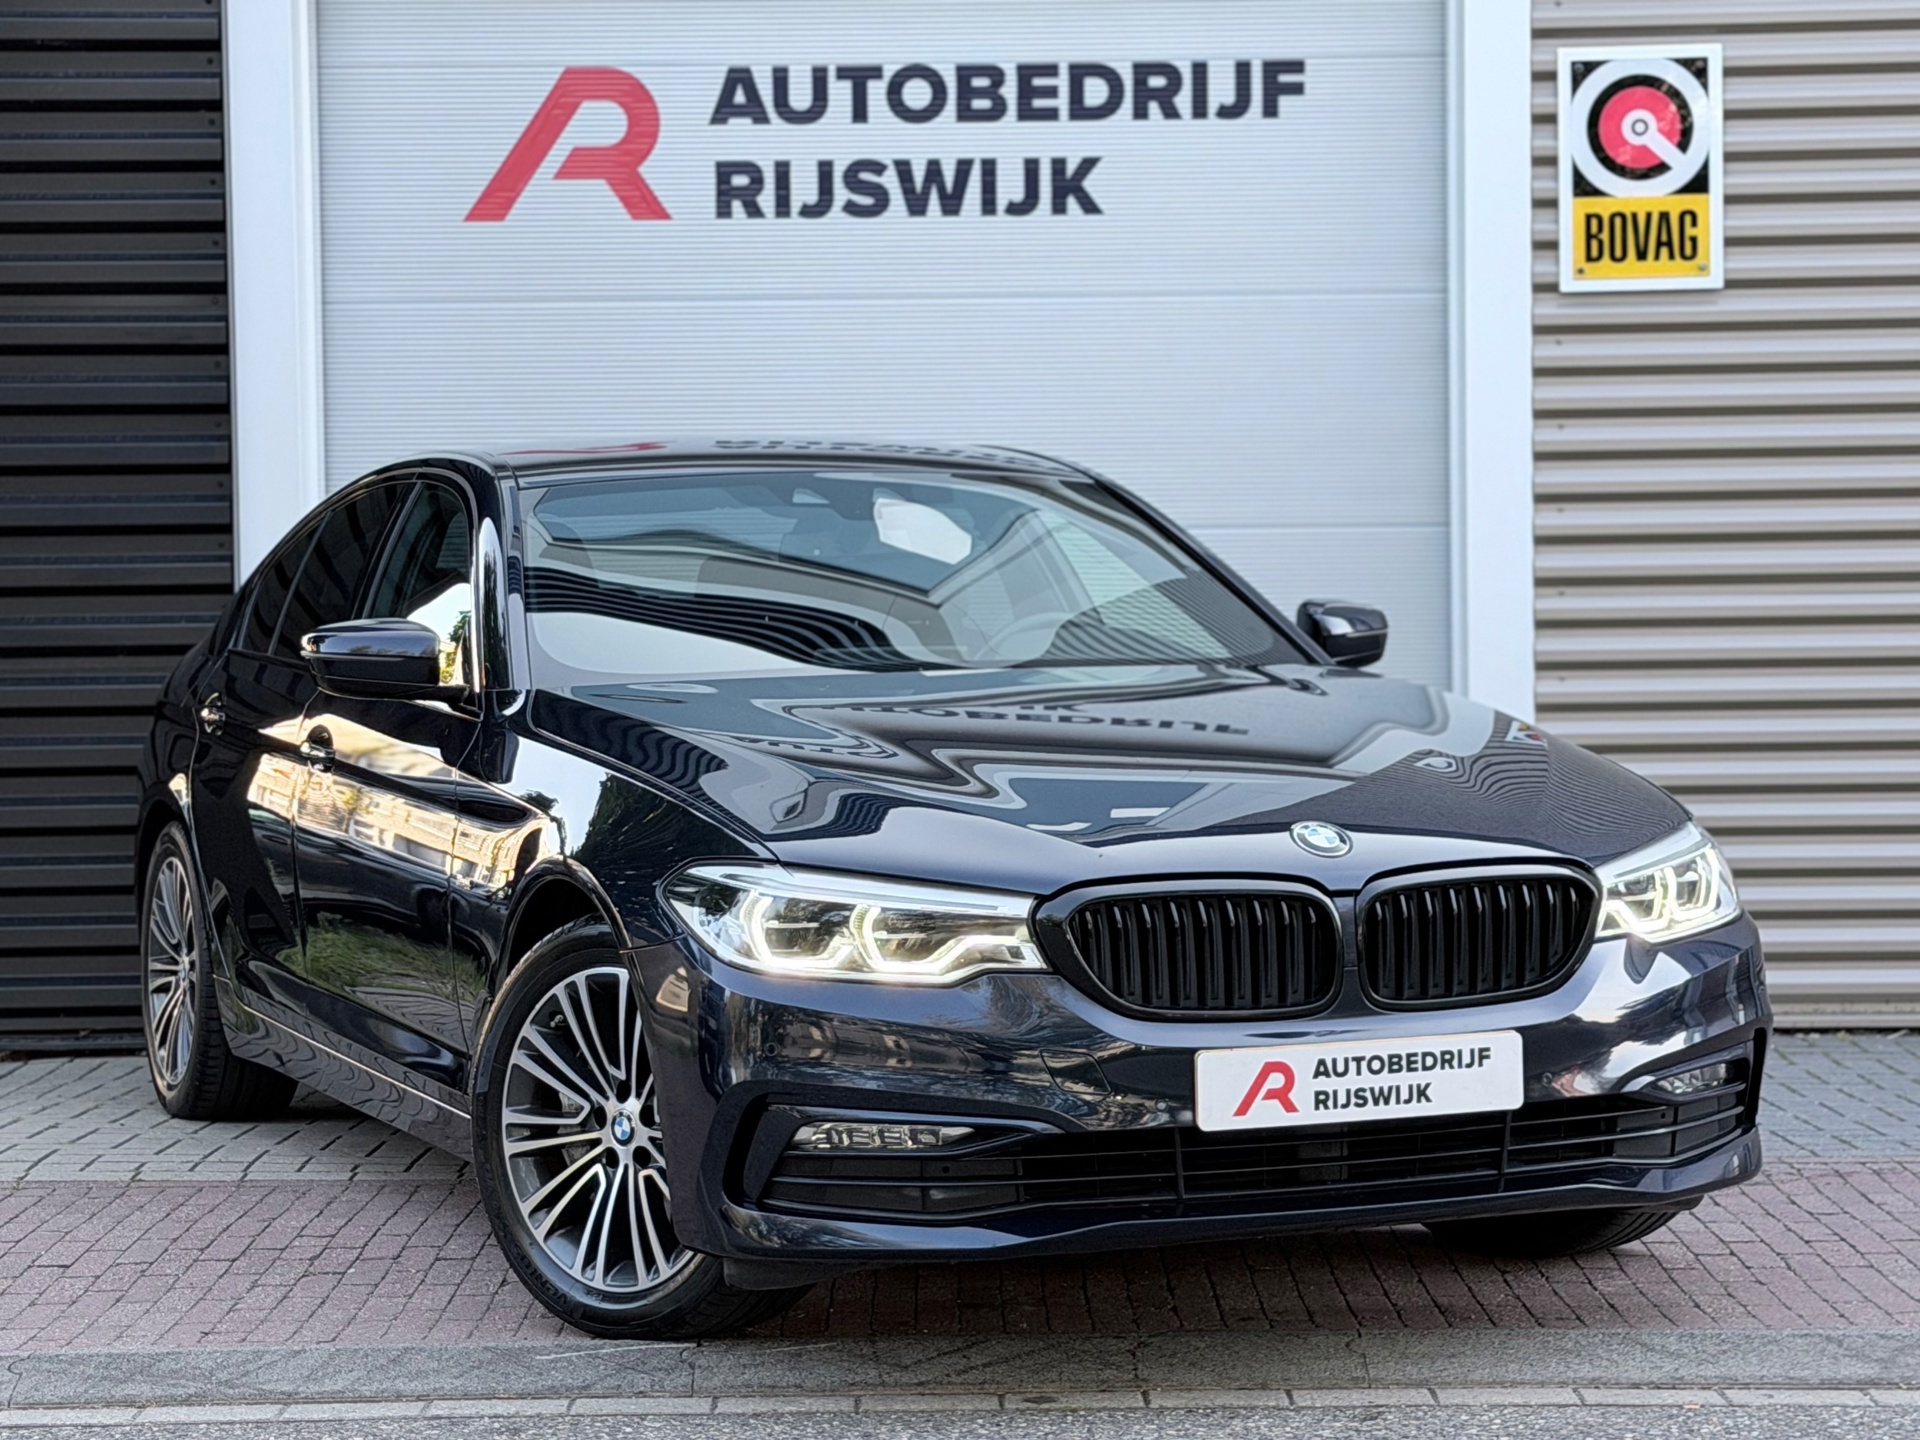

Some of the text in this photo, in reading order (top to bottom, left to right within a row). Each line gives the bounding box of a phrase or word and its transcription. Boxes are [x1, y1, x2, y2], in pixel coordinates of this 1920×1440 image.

[710, 60, 1305, 125] AUTOBEDRIJF
[715, 157, 1103, 219] RIJSWIJK
[1584, 210, 1699, 263] BOVAG
[1312, 1047, 1492, 1080] AUTOBEDRIJF
[1313, 1082, 1433, 1111] RIJSWIJK
